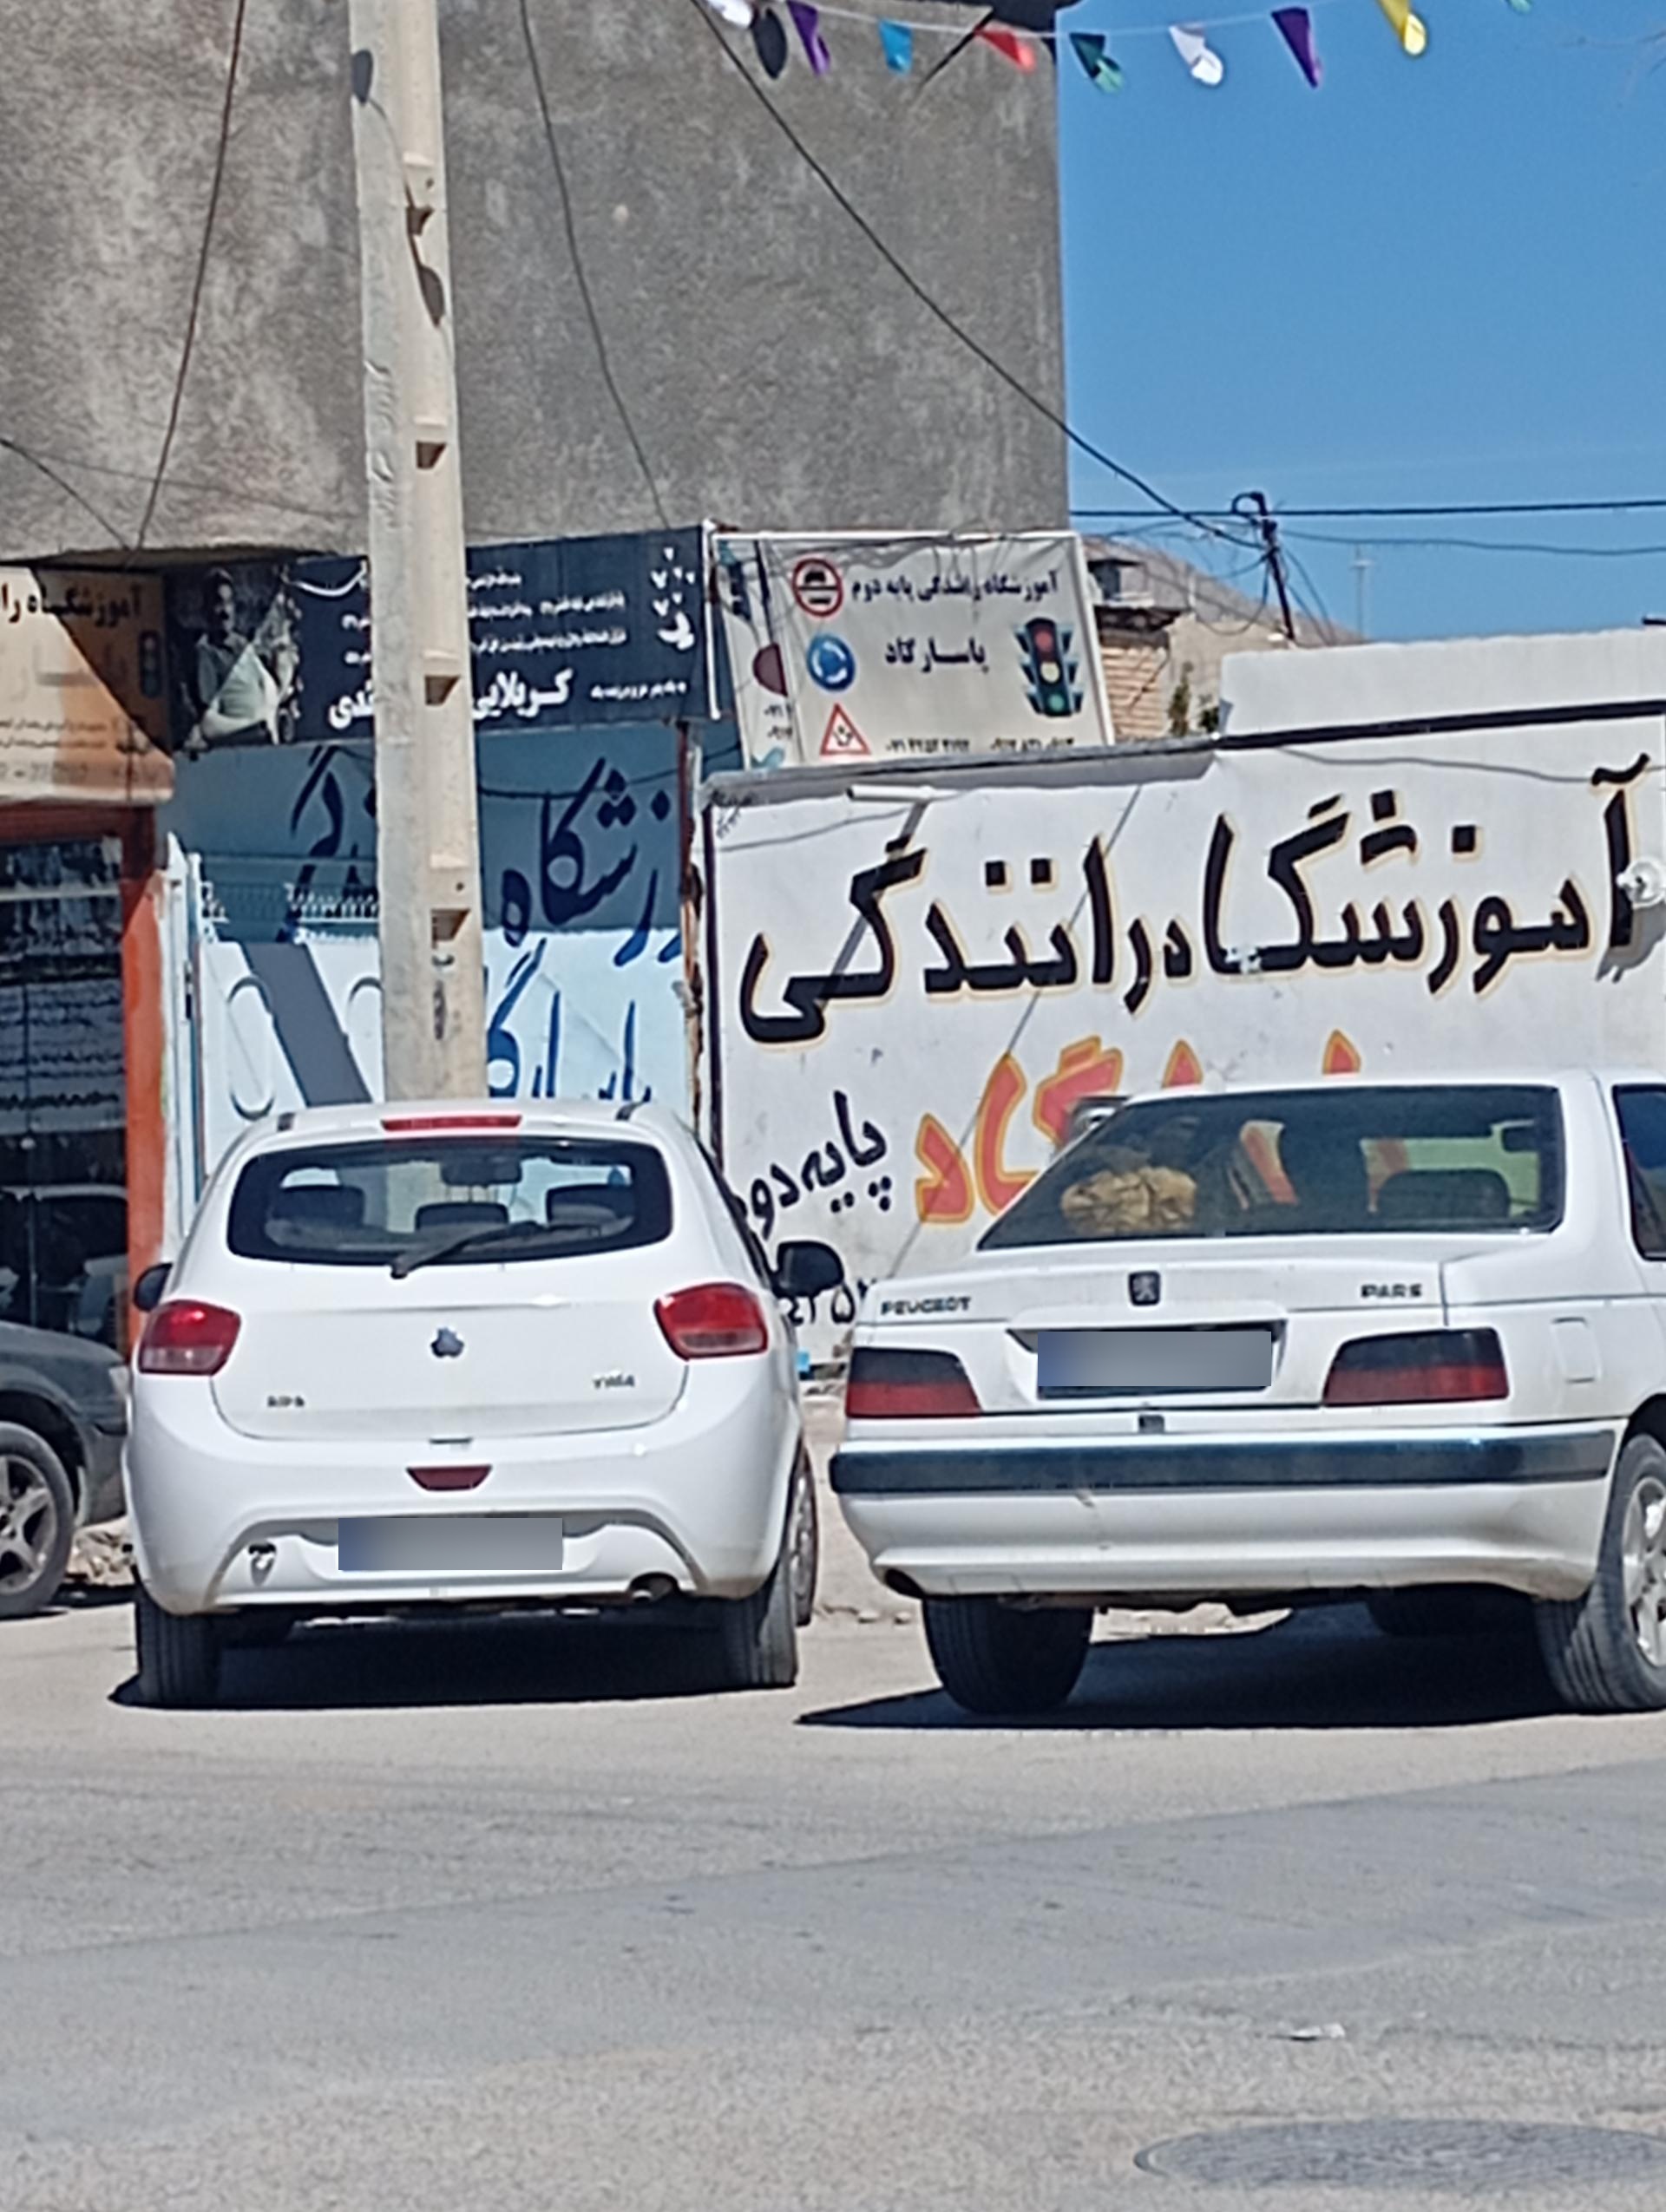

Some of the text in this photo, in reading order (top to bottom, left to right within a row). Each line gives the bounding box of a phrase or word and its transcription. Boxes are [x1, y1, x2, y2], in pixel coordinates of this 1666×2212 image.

[1163, 753, 1650, 995] آموزشگاه
[739, 834, 1154, 1044] رانندگی
[881, 1295, 972, 1316] PEUGEOT
[1361, 1282, 1424, 1299] PARS
